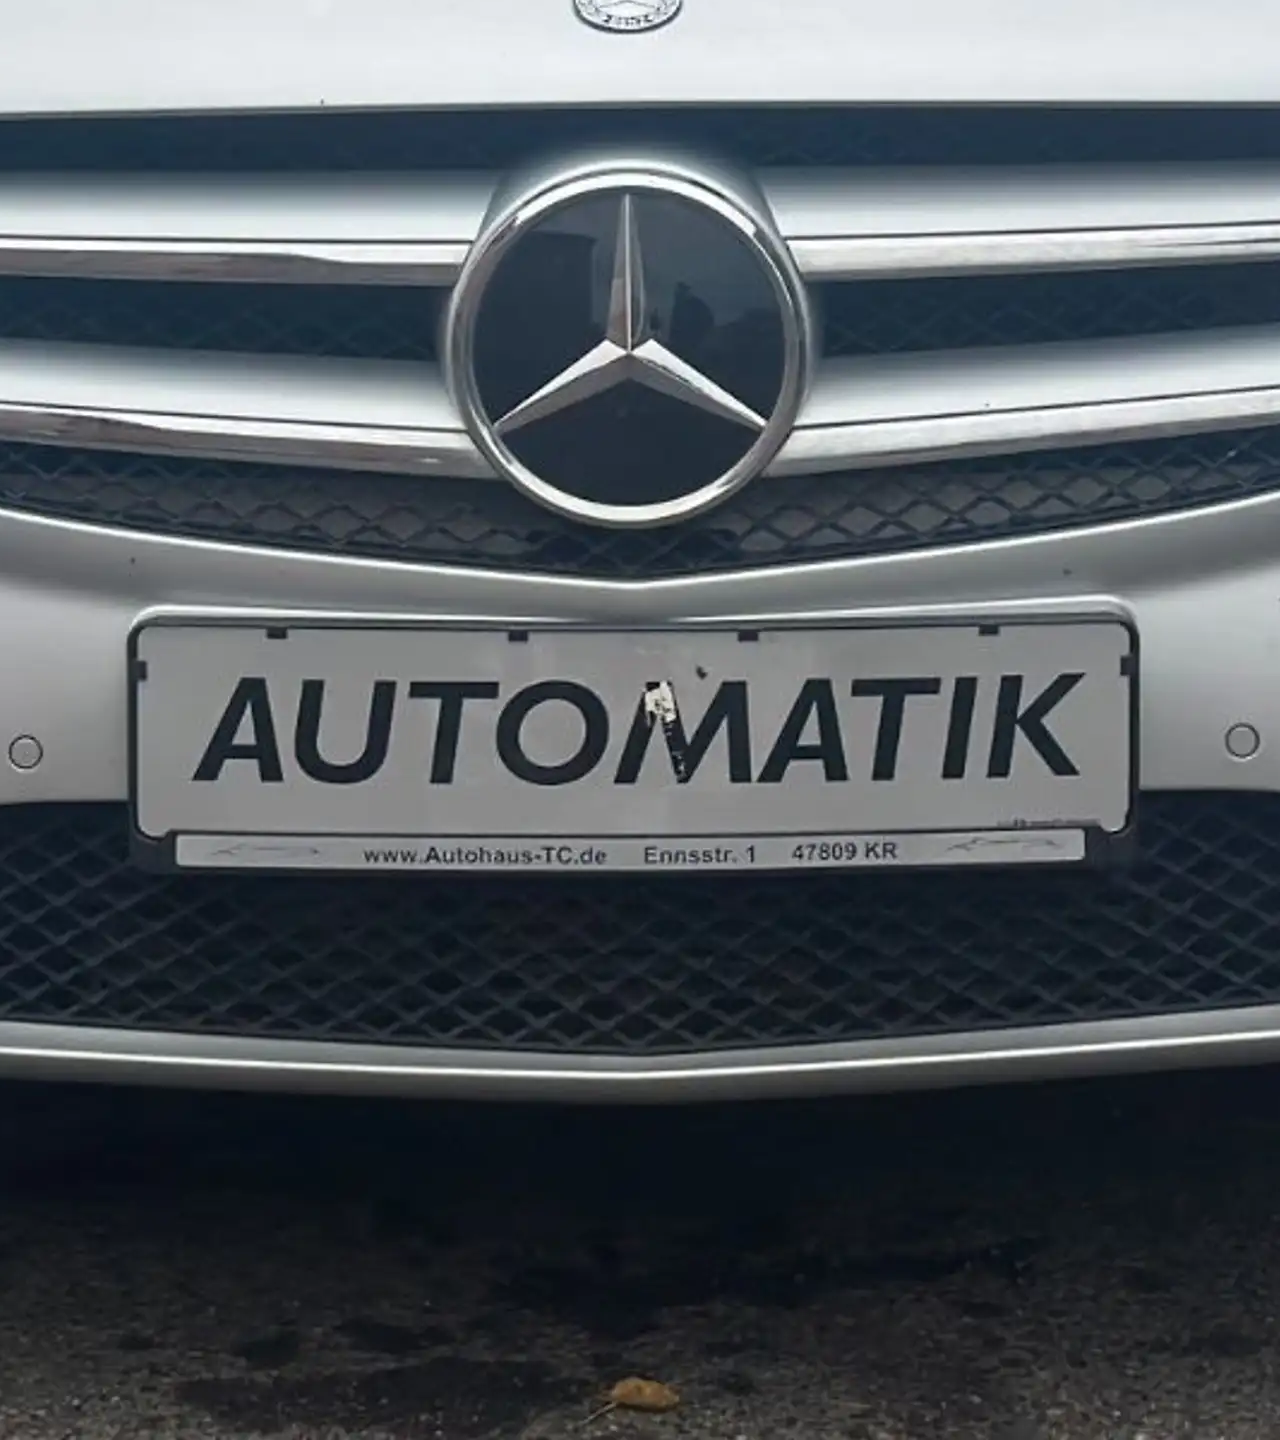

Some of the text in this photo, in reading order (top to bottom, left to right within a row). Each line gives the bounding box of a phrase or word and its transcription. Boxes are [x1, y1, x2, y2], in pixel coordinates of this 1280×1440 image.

[192, 672, 1086, 785] AUTOMATIK
[363, 841, 898, 865] www.Autohaus-TC.de Ennsstr. 1 47809 KR
